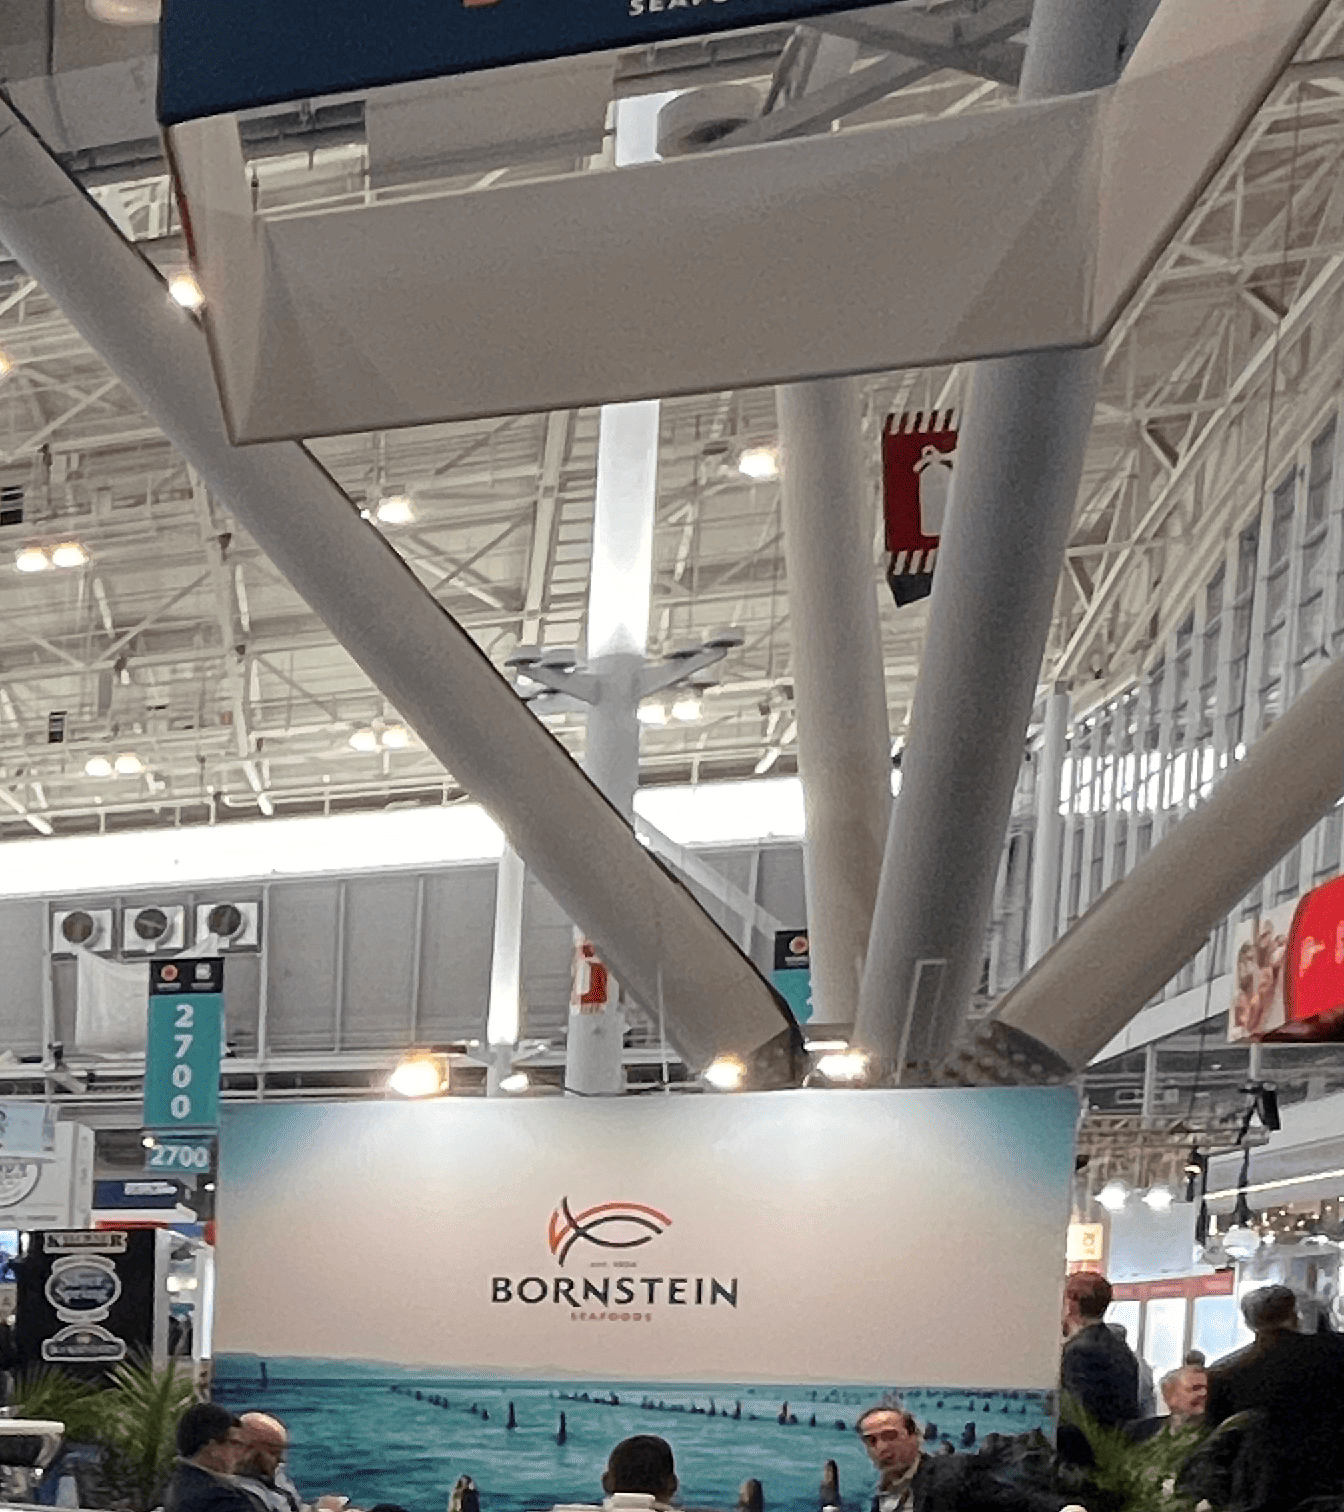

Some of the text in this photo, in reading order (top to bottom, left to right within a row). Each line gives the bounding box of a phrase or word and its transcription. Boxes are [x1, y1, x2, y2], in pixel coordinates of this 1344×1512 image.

[171, 1004, 194, 1119] 2700
[149, 1145, 210, 1168] 2700
[491, 1277, 738, 1308] BORNSTEIN
